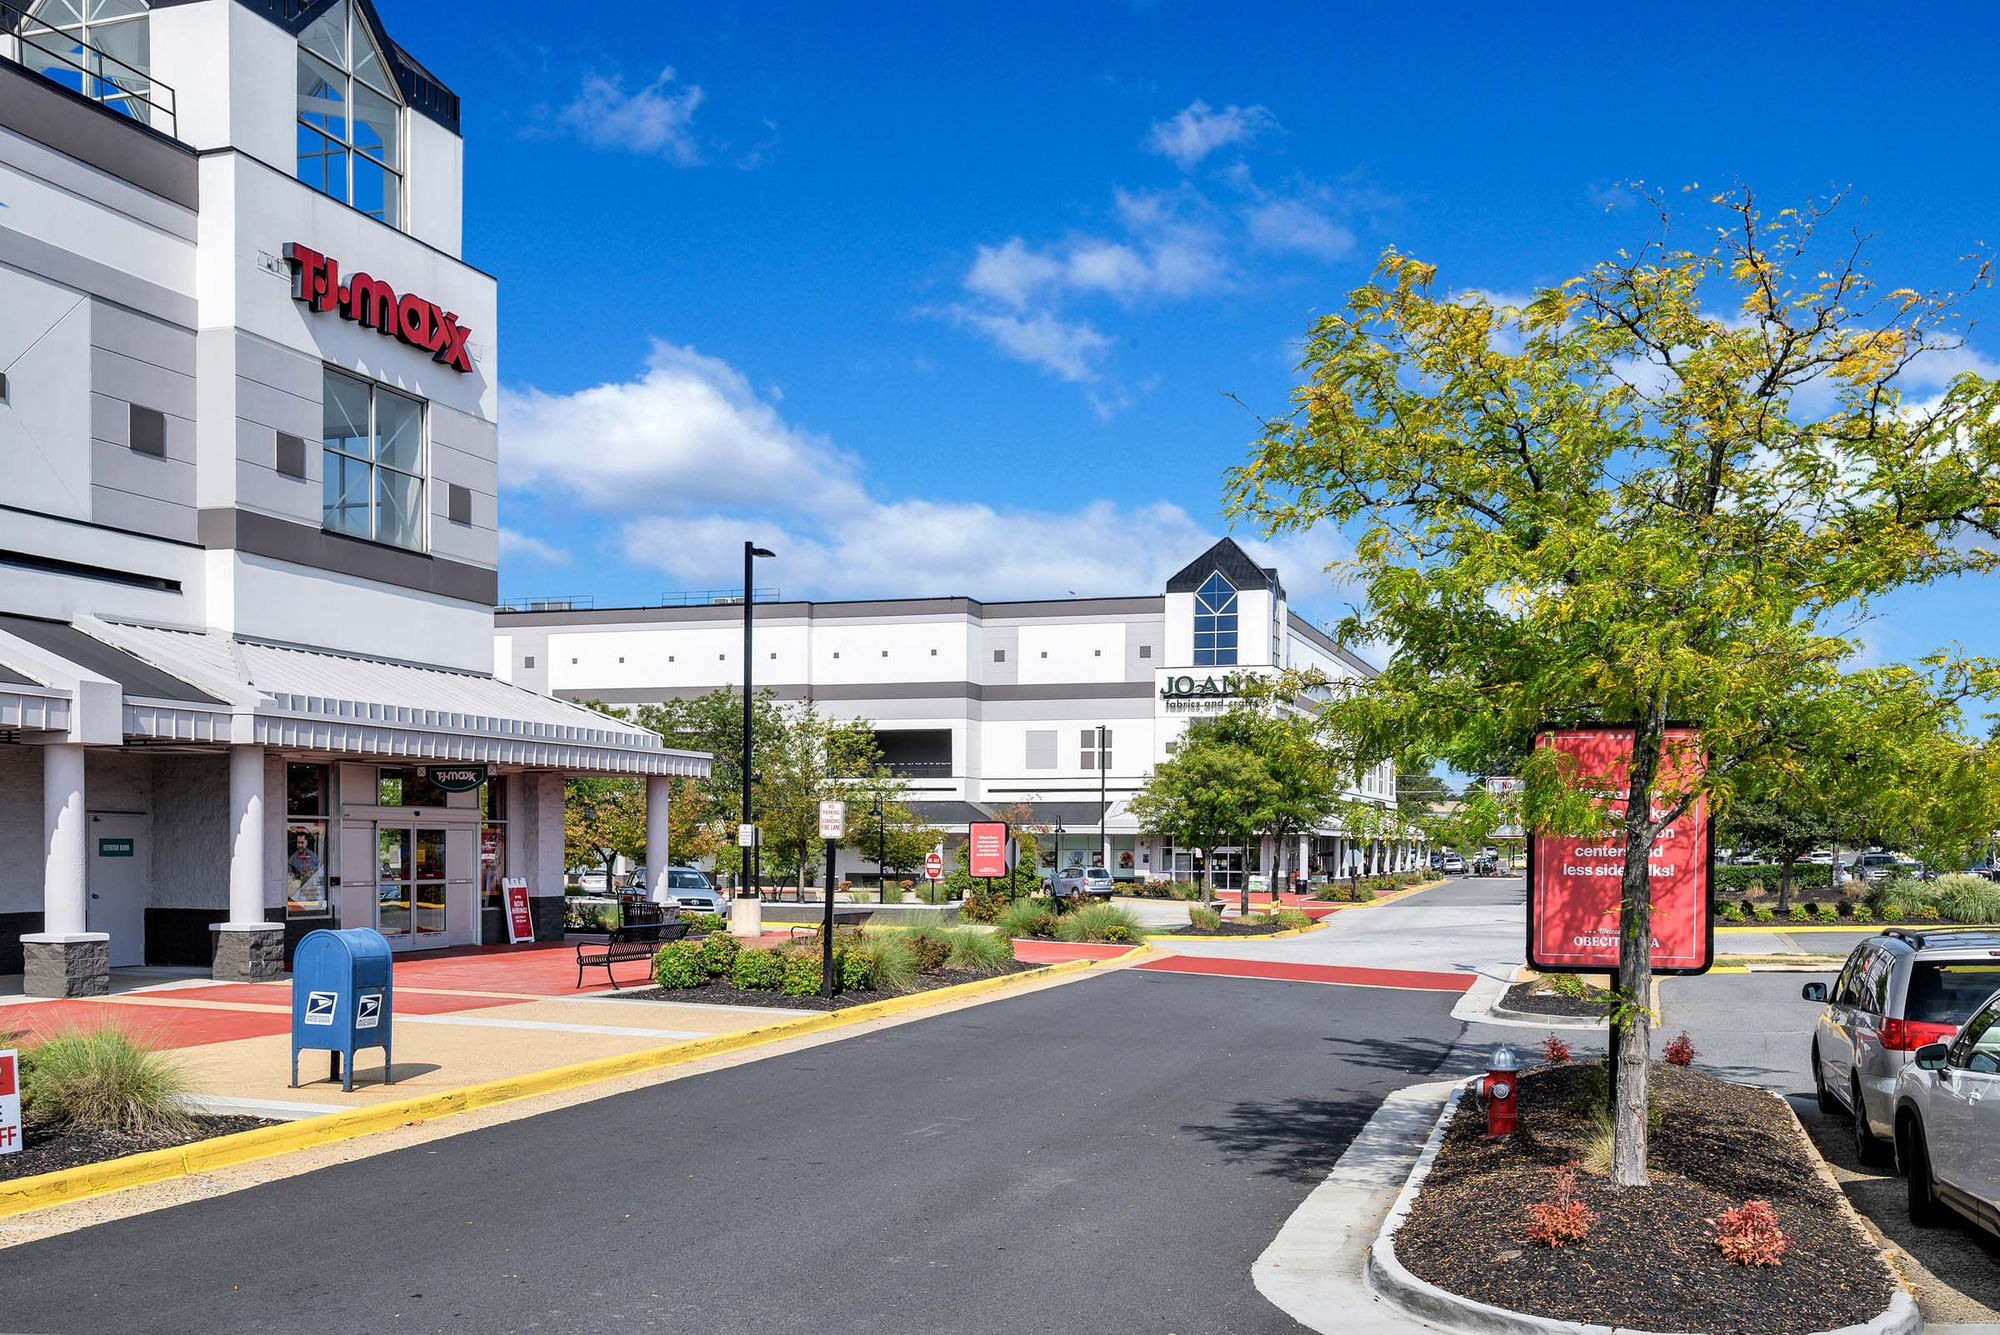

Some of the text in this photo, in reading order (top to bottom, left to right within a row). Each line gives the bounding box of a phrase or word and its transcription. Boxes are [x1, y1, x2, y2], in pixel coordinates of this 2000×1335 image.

[1165, 699, 1200, 709] fabrics
[1204, 698, 1224, 708] and
[1502, 781, 1513, 789] NO
[1563, 863, 1675, 877] less sidelks!
[1598, 927, 1620, 935] Welco
[1573, 935, 1621, 948] OBECIT
